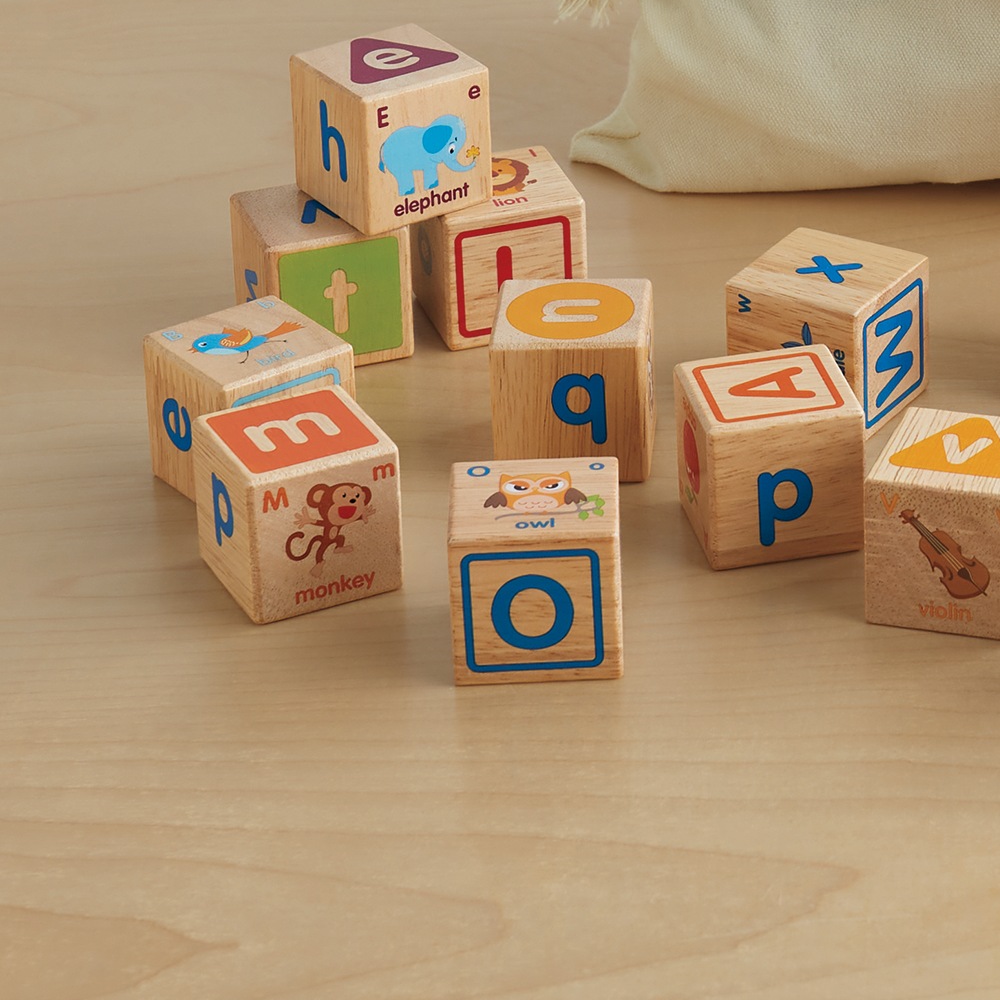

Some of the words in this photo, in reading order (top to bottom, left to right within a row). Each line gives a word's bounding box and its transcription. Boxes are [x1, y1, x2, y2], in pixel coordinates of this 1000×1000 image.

[362, 47, 420, 70] e
[467, 85, 481, 100] e
[376, 106, 390, 129] E
[319, 99, 348, 183] h
[393, 182, 470, 217] elephant
[492, 196, 528, 207] lion
[323, 268, 358, 334] t
[255, 348, 296, 367] bird
[728, 366, 816, 399] A
[551, 373, 608, 445] q
[162, 397, 192, 452] e
[242, 411, 342, 453] m
[371, 462, 396, 482] m
[211, 471, 234, 547] p
[261, 486, 290, 514] M
[514, 518, 555, 530] owl
[295, 571, 376, 605] monkey
[918, 600, 973, 623] violin
